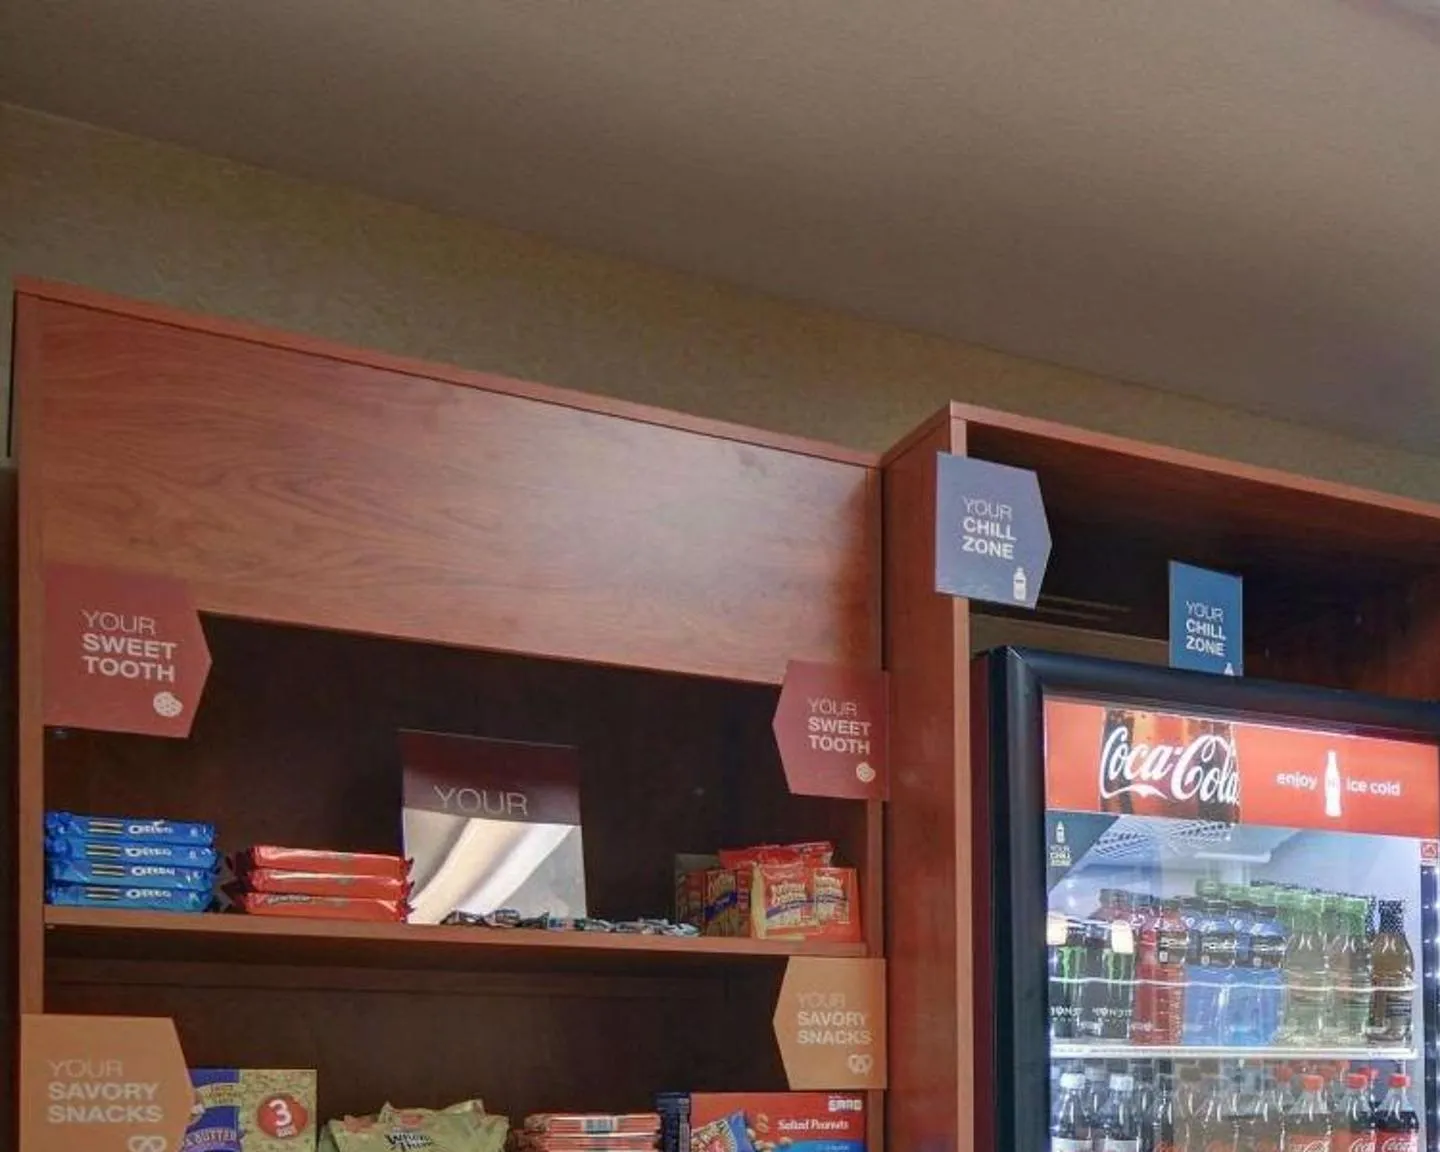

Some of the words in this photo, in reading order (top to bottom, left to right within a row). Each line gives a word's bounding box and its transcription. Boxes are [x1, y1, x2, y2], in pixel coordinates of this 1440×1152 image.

[963, 497, 1012, 520] YOUR
[963, 516, 1016, 541] CHILL
[962, 535, 1013, 560] ZONE
[1186, 600, 1224, 622] YOUR
[82, 609, 156, 635] YOUR
[1186, 619, 1226, 640] CHILL
[83, 633, 177, 660] SWEET
[1186, 636, 1224, 657] ZONE
[83, 656, 176, 682] TOOTH
[808, 698, 857, 715] YOUR
[808, 716, 870, 736] SWEET
[809, 735, 870, 754] TOOTH
[1277, 771, 1317, 791] enjoy
[1346, 776, 1367, 793] ice
[1370, 779, 1400, 796] cold
[433, 785, 528, 816] YOUR
[798, 1011, 865, 1026] SAVORY
[798, 1029, 872, 1044] SNACKS
[48, 1060, 123, 1078] YOUR
[48, 1082, 159, 1101] SAVORY
[48, 1105, 163, 1123] SNACKS
[269, 1099, 292, 1126] 3
